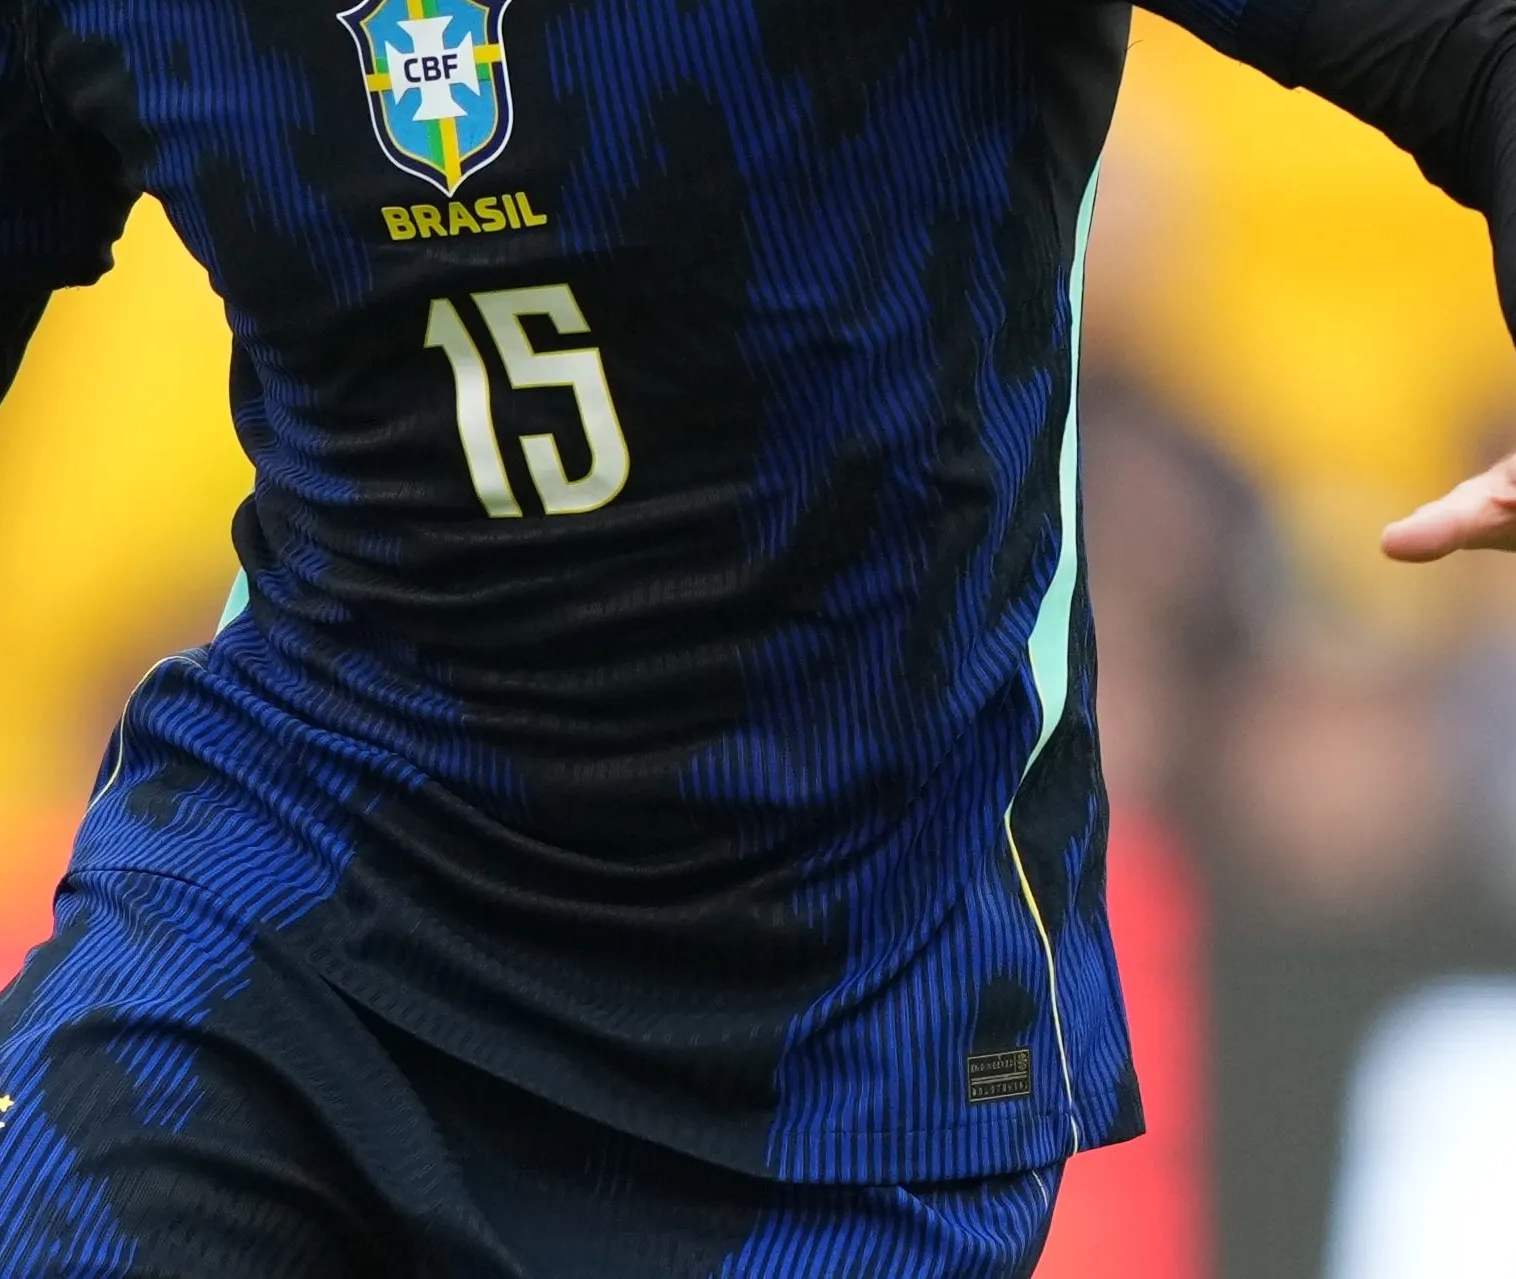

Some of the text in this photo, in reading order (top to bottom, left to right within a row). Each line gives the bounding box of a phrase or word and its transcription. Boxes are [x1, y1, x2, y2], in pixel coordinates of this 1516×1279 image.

[404, 54, 458, 83] CBF
[381, 191, 547, 241] BRASIL
[423, 283, 630, 518] 15
